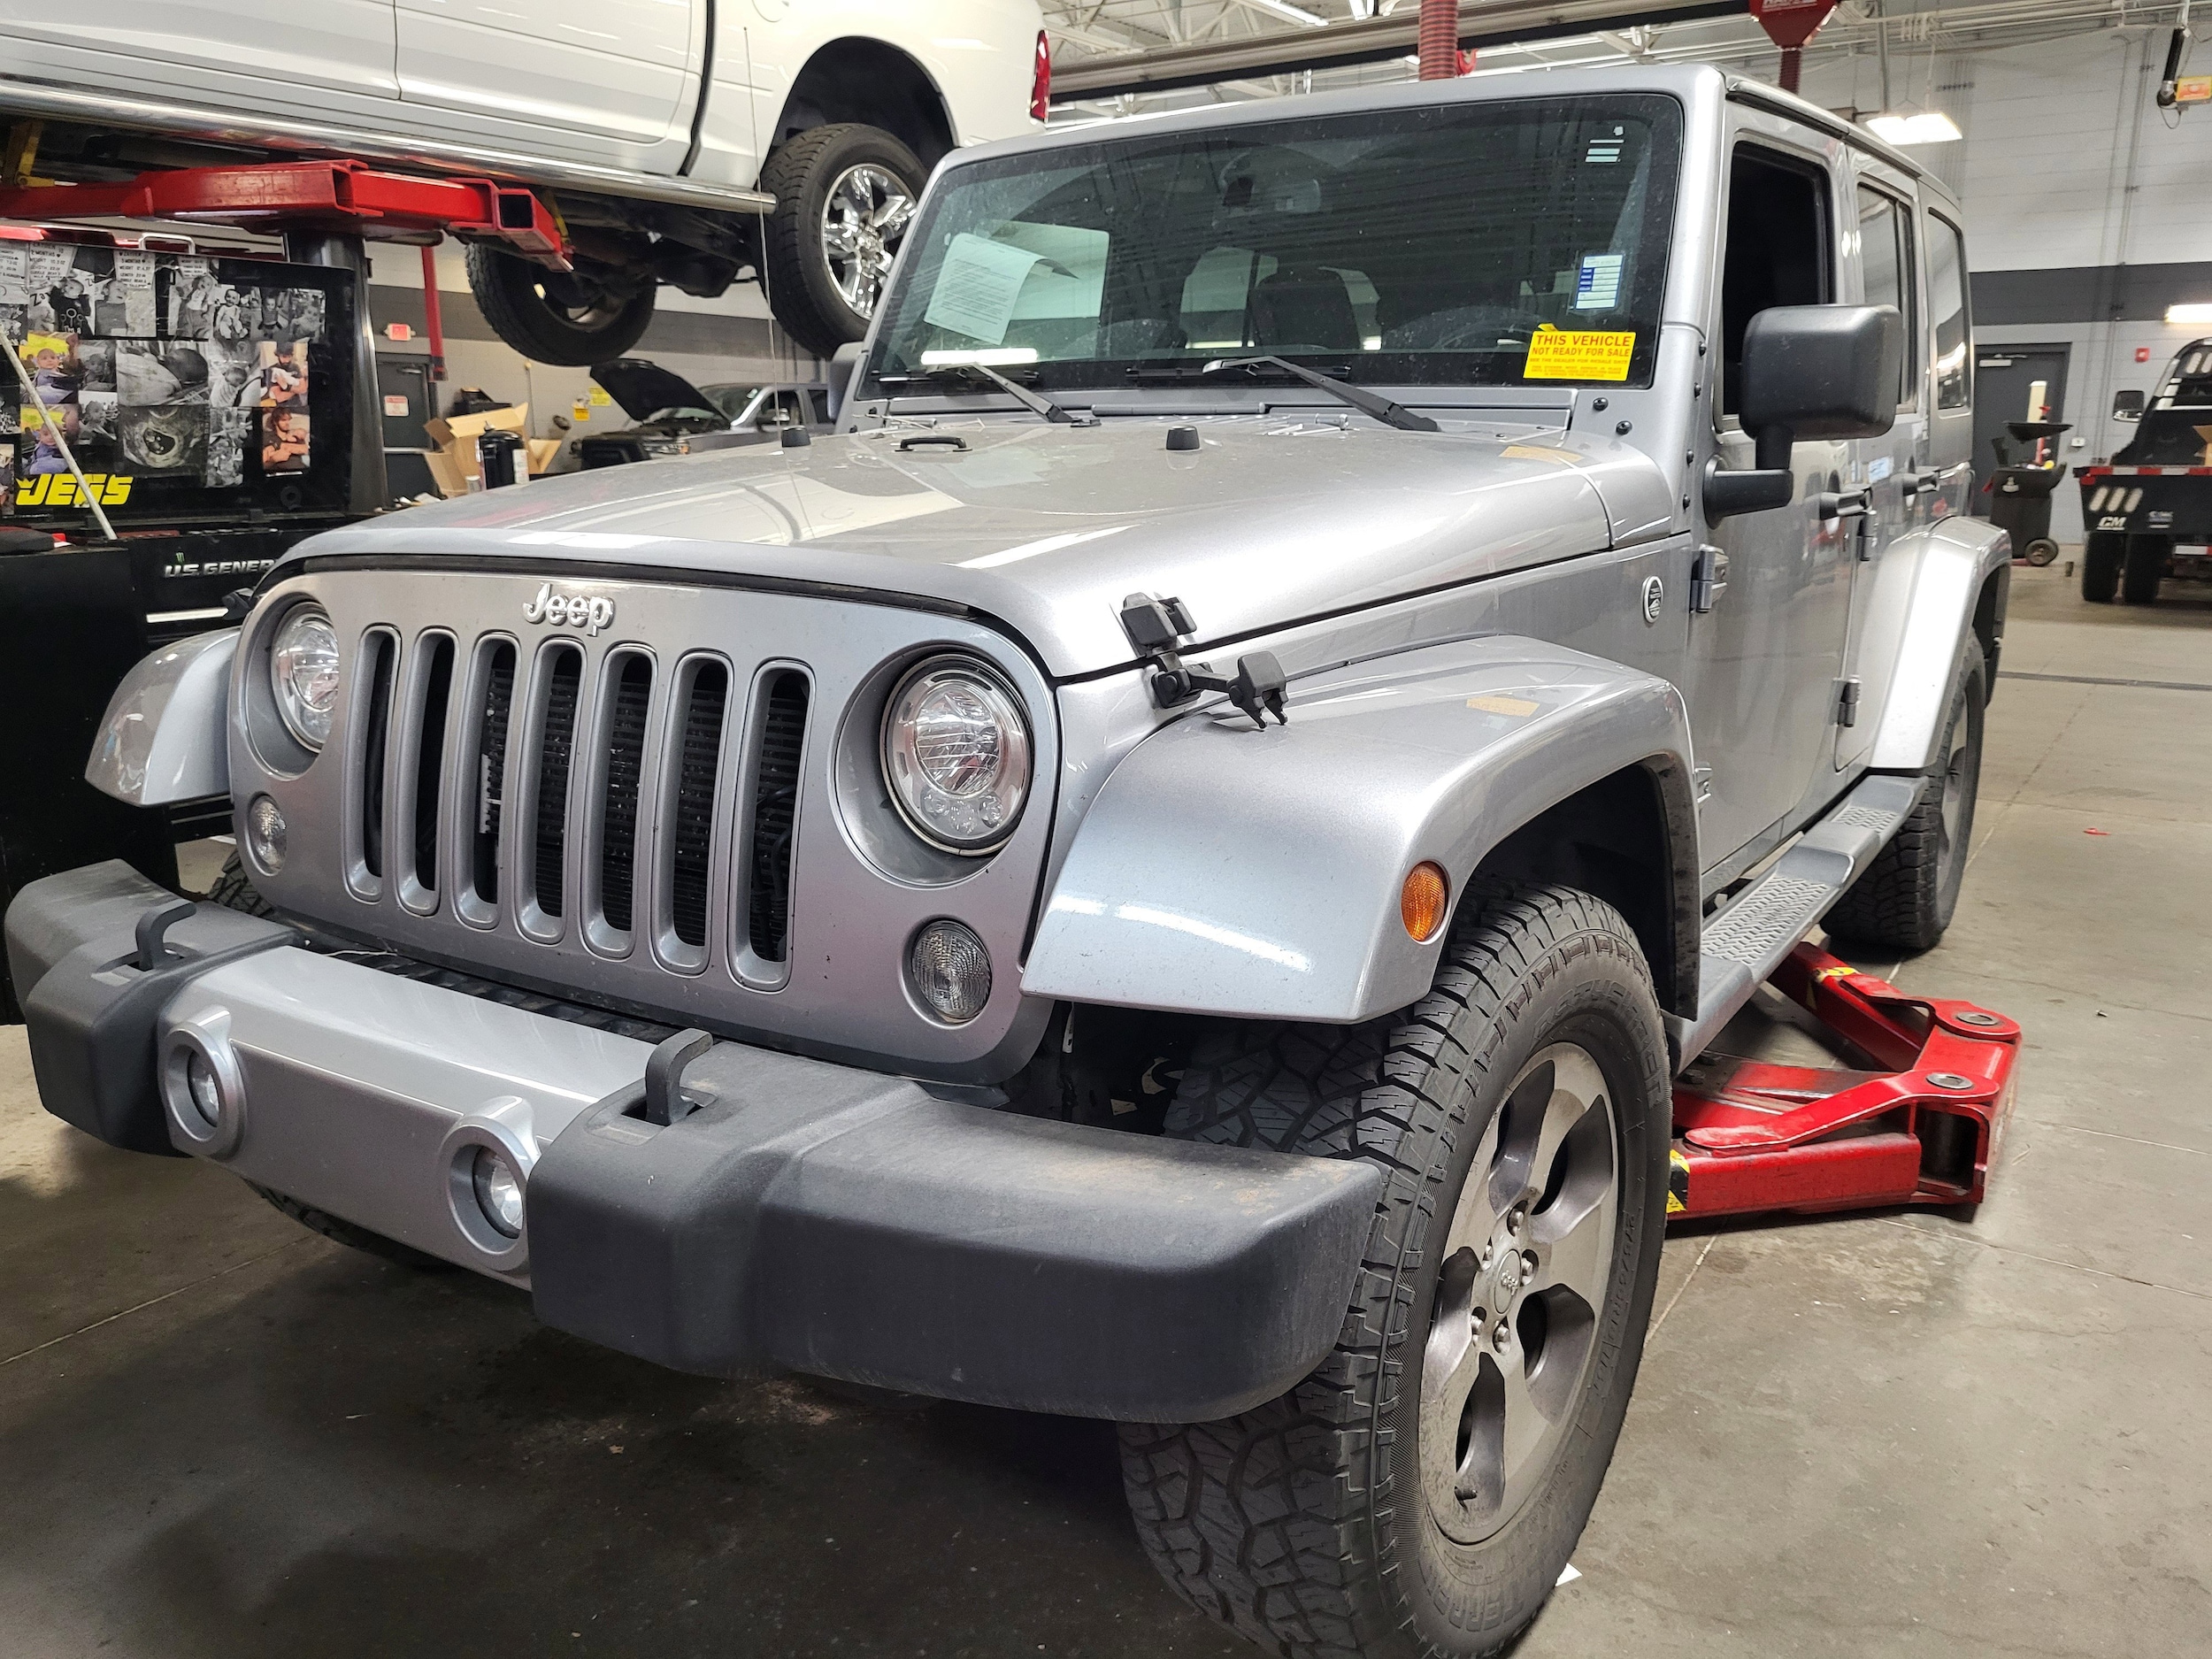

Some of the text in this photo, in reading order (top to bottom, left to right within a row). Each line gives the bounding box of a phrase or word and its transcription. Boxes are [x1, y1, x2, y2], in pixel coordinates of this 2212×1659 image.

[1537, 334, 1632, 347] THIS VEHICLE
[1532, 347, 1630, 357] NOT READY FOR SALE
[15, 473, 134, 506] JEGS
[2099, 516, 2127, 527] CM
[522, 583, 616, 637] Jeep
